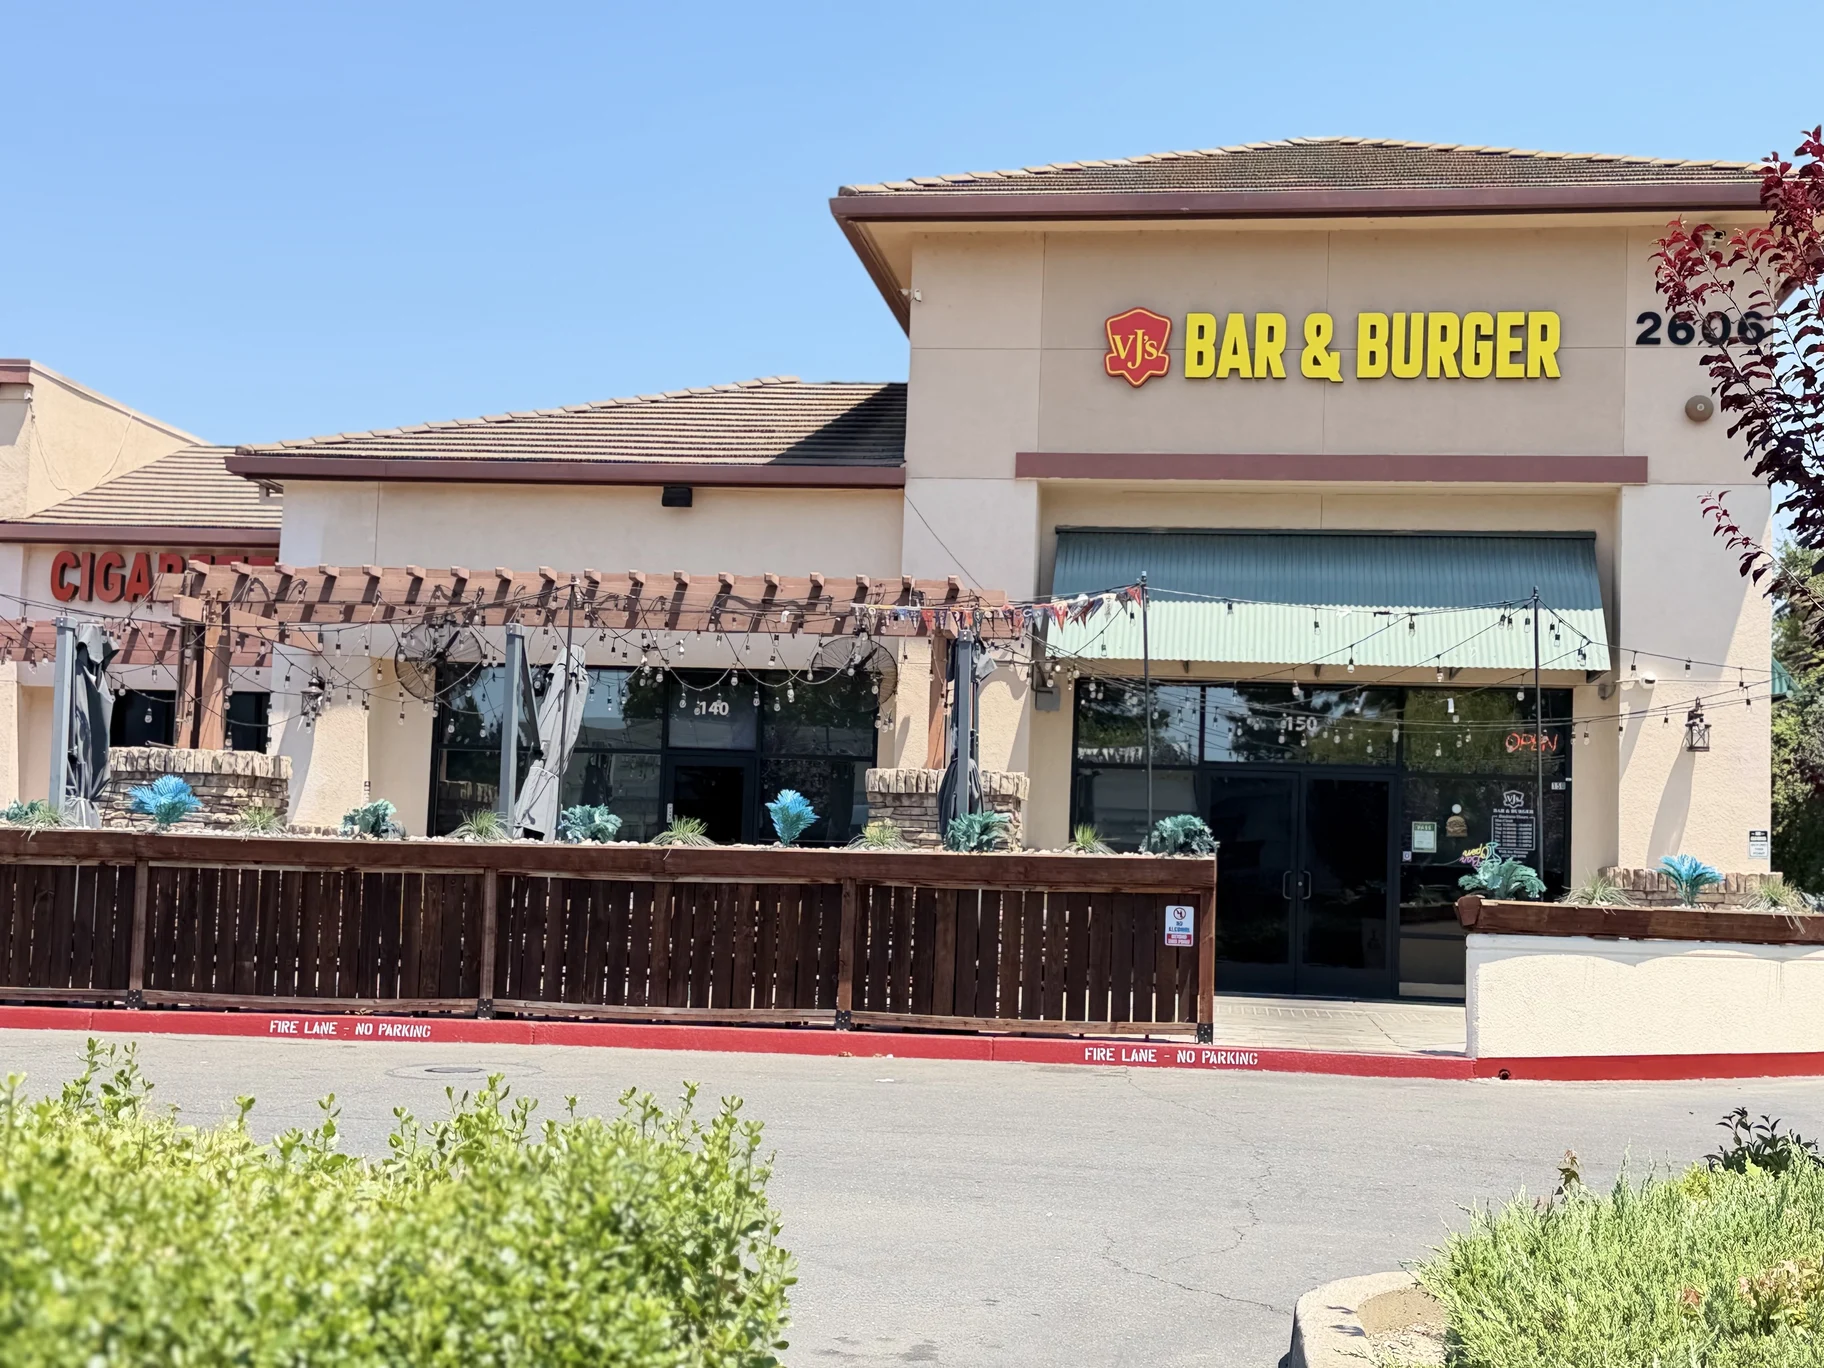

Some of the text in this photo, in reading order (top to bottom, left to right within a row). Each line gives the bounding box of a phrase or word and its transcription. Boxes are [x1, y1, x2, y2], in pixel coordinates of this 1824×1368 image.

[1635, 311, 1766, 345] 2606
[1113, 328, 1159, 369] VJ's
[1184, 311, 1562, 382] BAR & BURGER
[699, 701, 730, 716] 140
[1286, 716, 1318, 731] 150
[1505, 732, 1559, 753] OPEN
[269, 1020, 300, 1034] FIRE
[304, 1022, 338, 1035] LANE
[355, 1023, 373, 1036] NO
[378, 1023, 432, 1038] PARKING
[1084, 1047, 1115, 1061] FIRE
[1121, 1049, 1157, 1063] LANE
[1176, 1050, 1196, 1064] NO
[1202, 1050, 1259, 1065] PARKING
